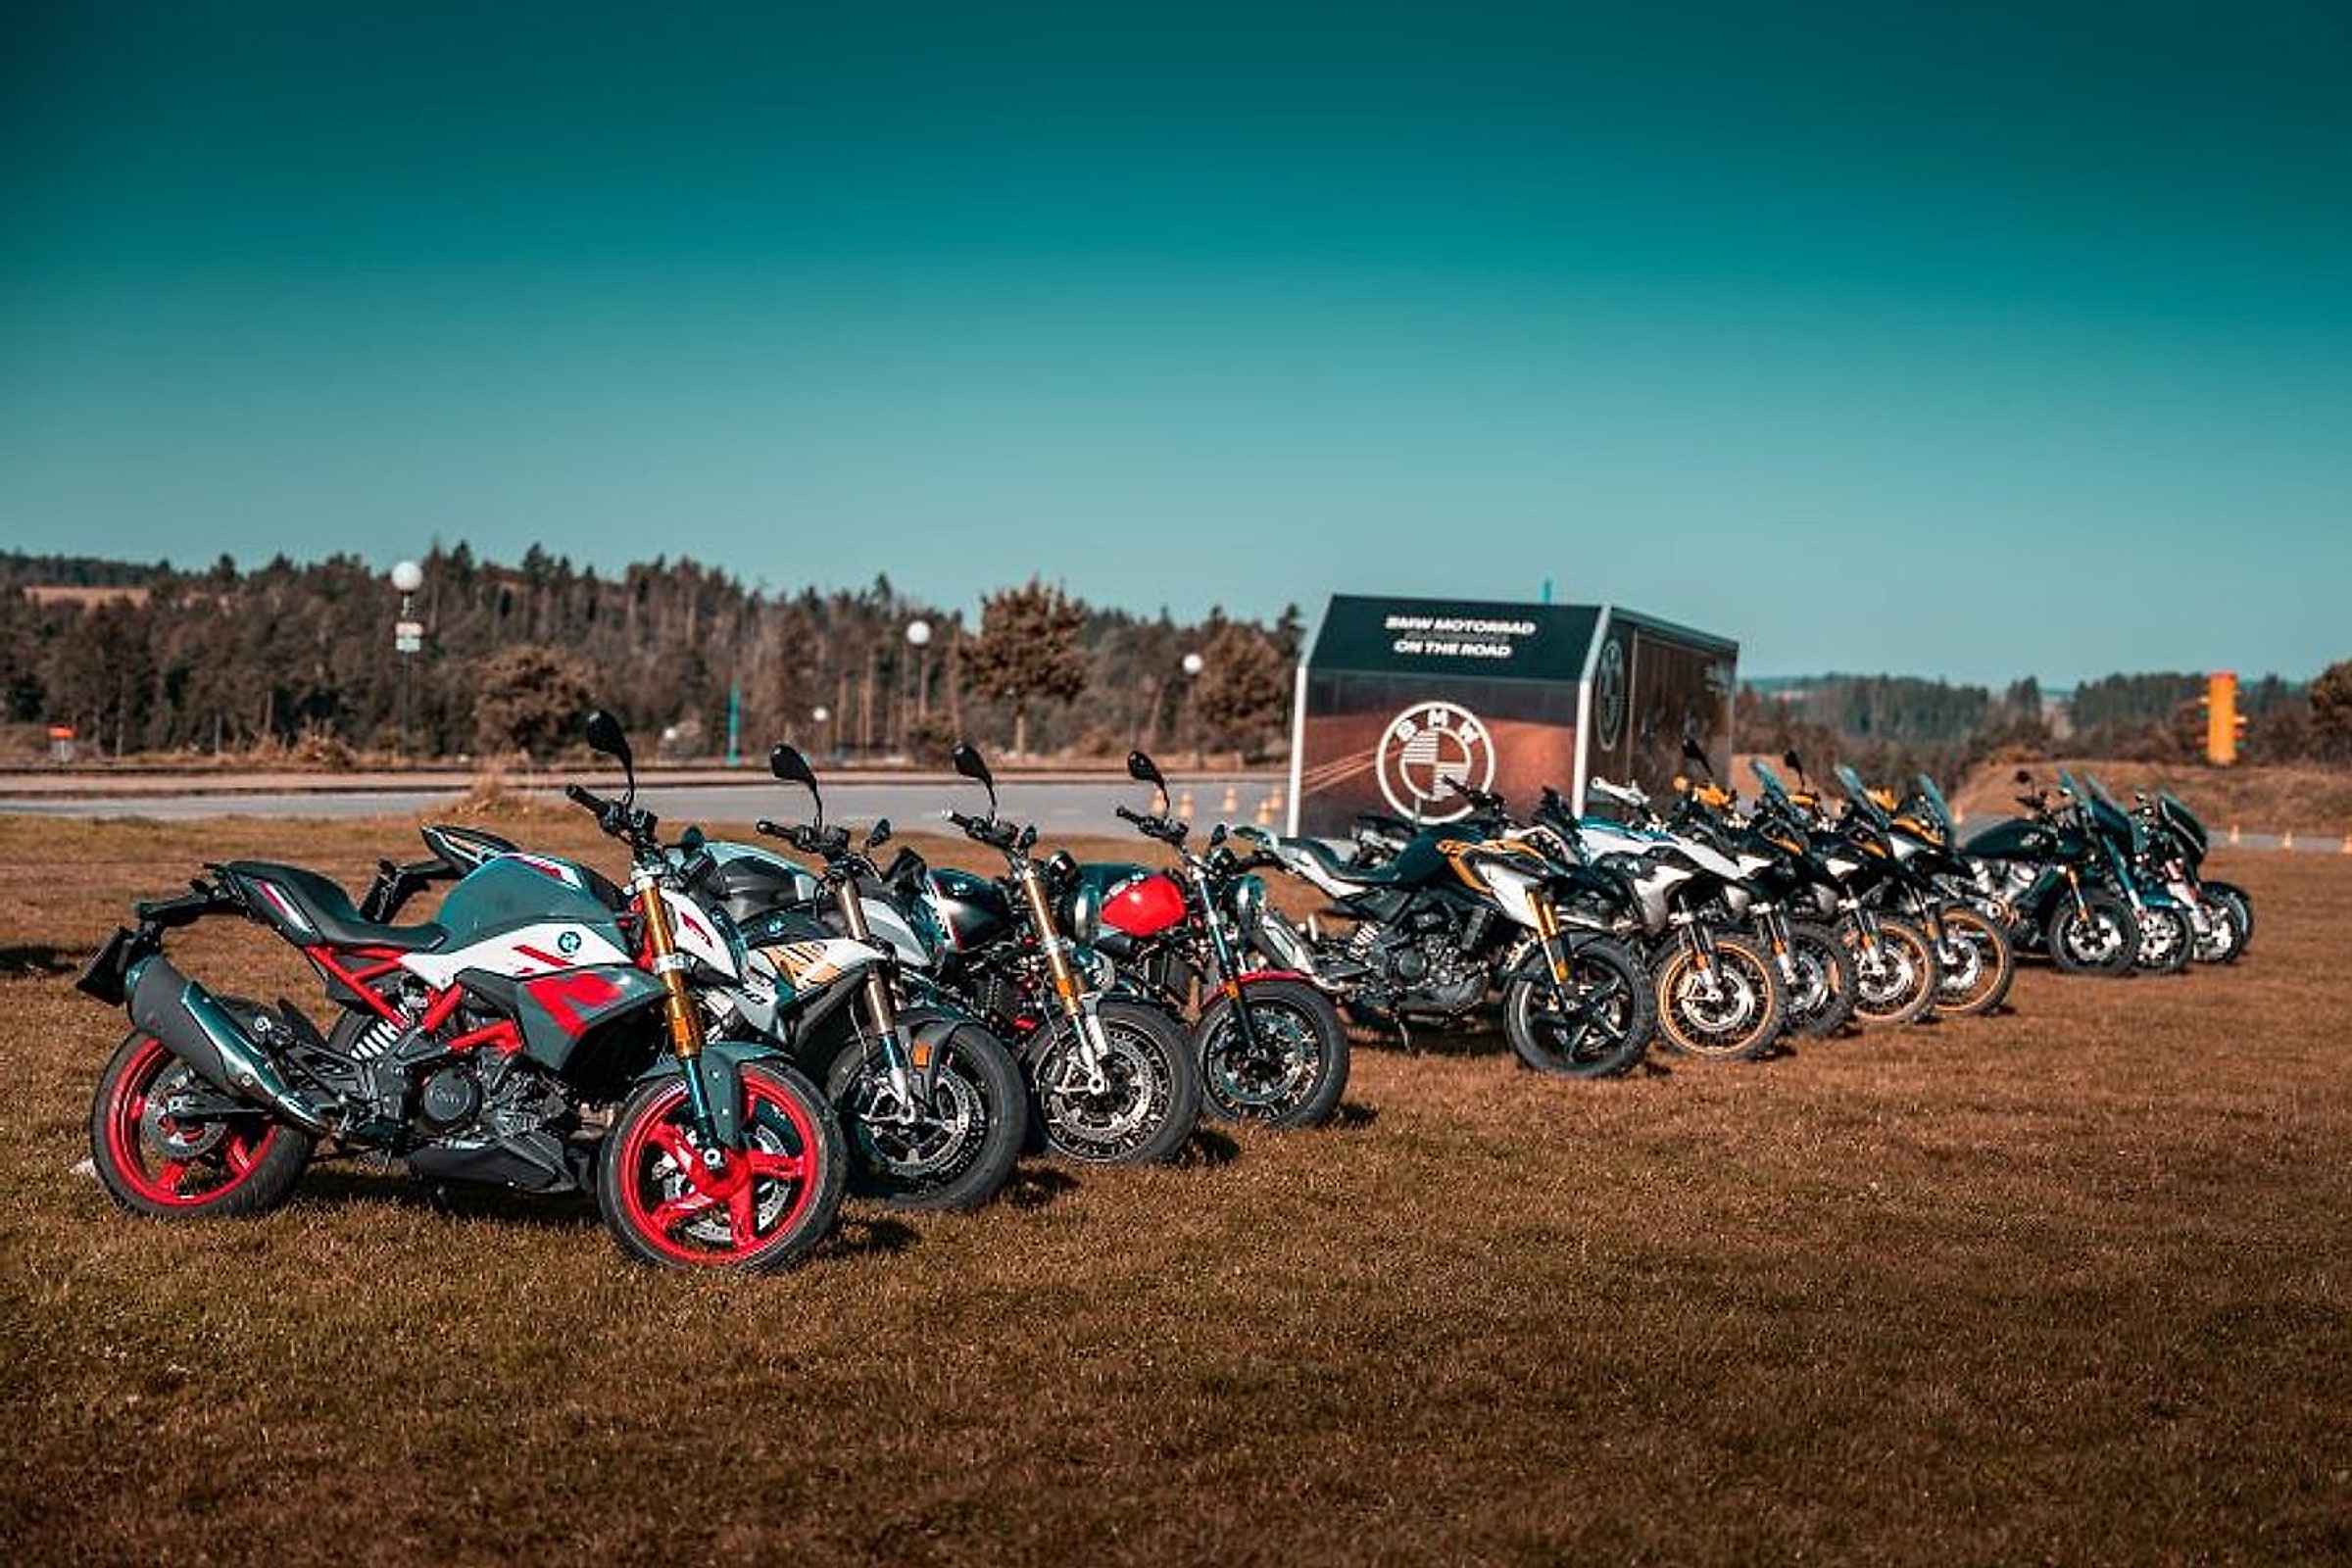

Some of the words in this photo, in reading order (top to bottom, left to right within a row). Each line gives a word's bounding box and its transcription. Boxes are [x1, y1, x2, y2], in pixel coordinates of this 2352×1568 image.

[1386, 615, 1434, 630] BMW
[1434, 617, 1536, 634] MOTORRAD
[1394, 641, 1422, 653] ON
[1424, 642, 1459, 656] THE
[1459, 644, 1512, 659] ROAD
